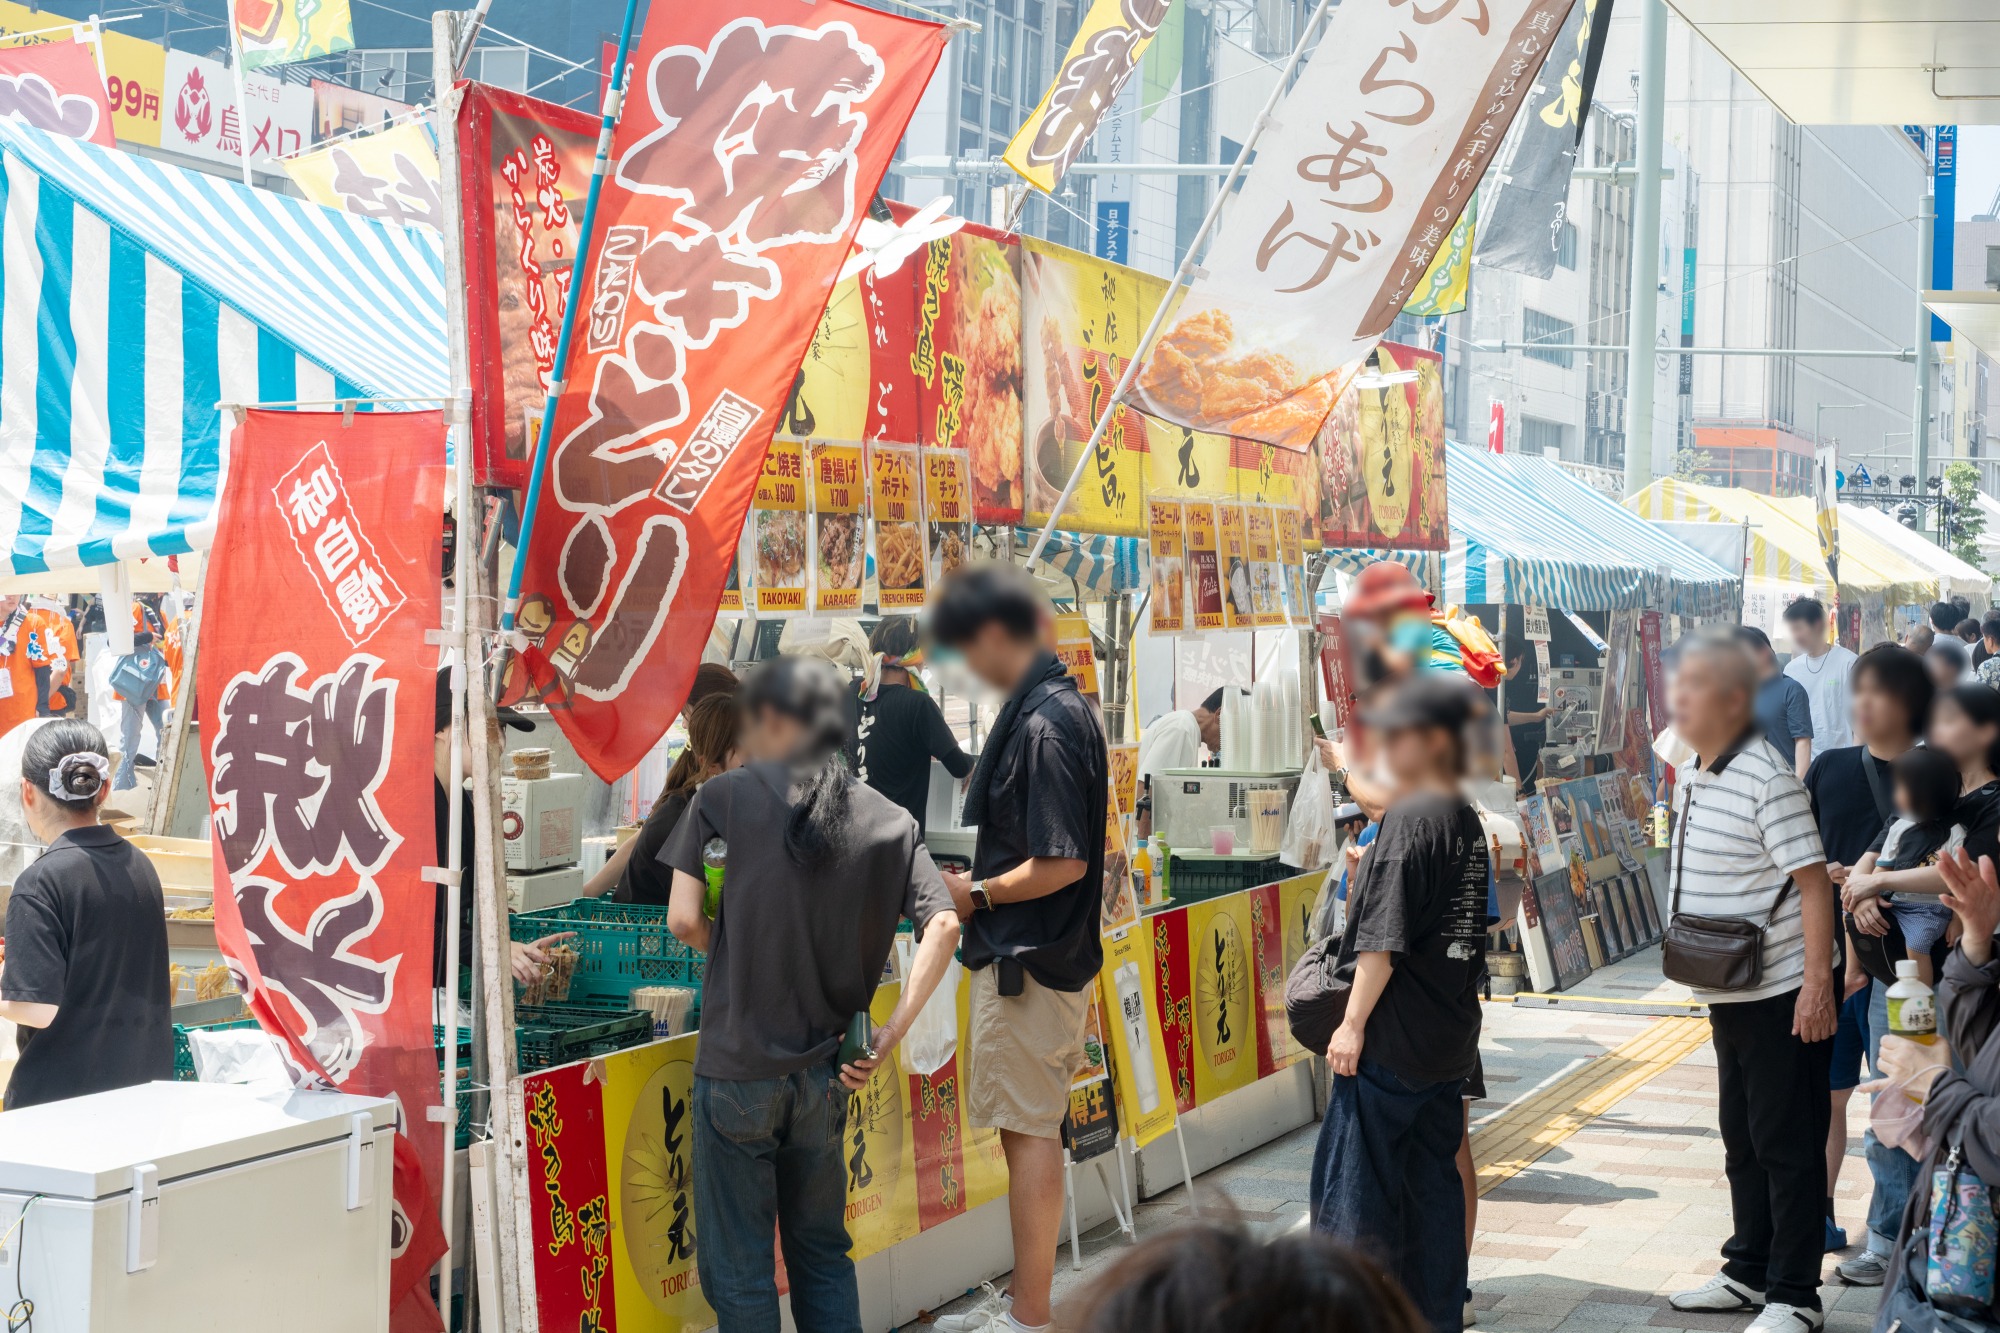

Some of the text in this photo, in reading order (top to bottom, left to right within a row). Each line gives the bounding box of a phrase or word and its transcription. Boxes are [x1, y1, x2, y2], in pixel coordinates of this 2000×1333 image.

[244, 83, 281, 103] 三代目
[216, 104, 300, 160] 鳥メロ
[1110, 103, 1122, 193] システムエスート
[1389, 10, 1555, 305] 真心を込めた手作りの美味しさ
[593, 235, 637, 345] こだわり
[811, 442, 827, 461] BIG!!
[820, 457, 857, 485] 唐揚げ
[874, 453, 912, 475] フライド
[775, 484, 796, 504] ¥600
[881, 477, 909, 498] ポテト
[830, 489, 849, 508] ¥700
[888, 501, 905, 521] ¥400
[940, 501, 959, 519] ¥500
[1151, 505, 1180, 525] 生ビール
[719, 594, 740, 606] ORTER
[761, 592, 801, 605] TAKOYAKI
[823, 594, 857, 606] KARAAGE
[881, 591, 924, 604] FRENCH FRIES
[1113, 768, 1131, 785] リンク
[1155, 919, 1176, 1032] 焼き鳥
[1176, 994, 1192, 1105] 揚げ物
[937, 1075, 958, 1210] 揚げ物
[528, 1080, 575, 1256] 焼き鳥
[844, 1190, 883, 1222] TORIGEN
[660, 1274, 701, 1298] TORIGE
